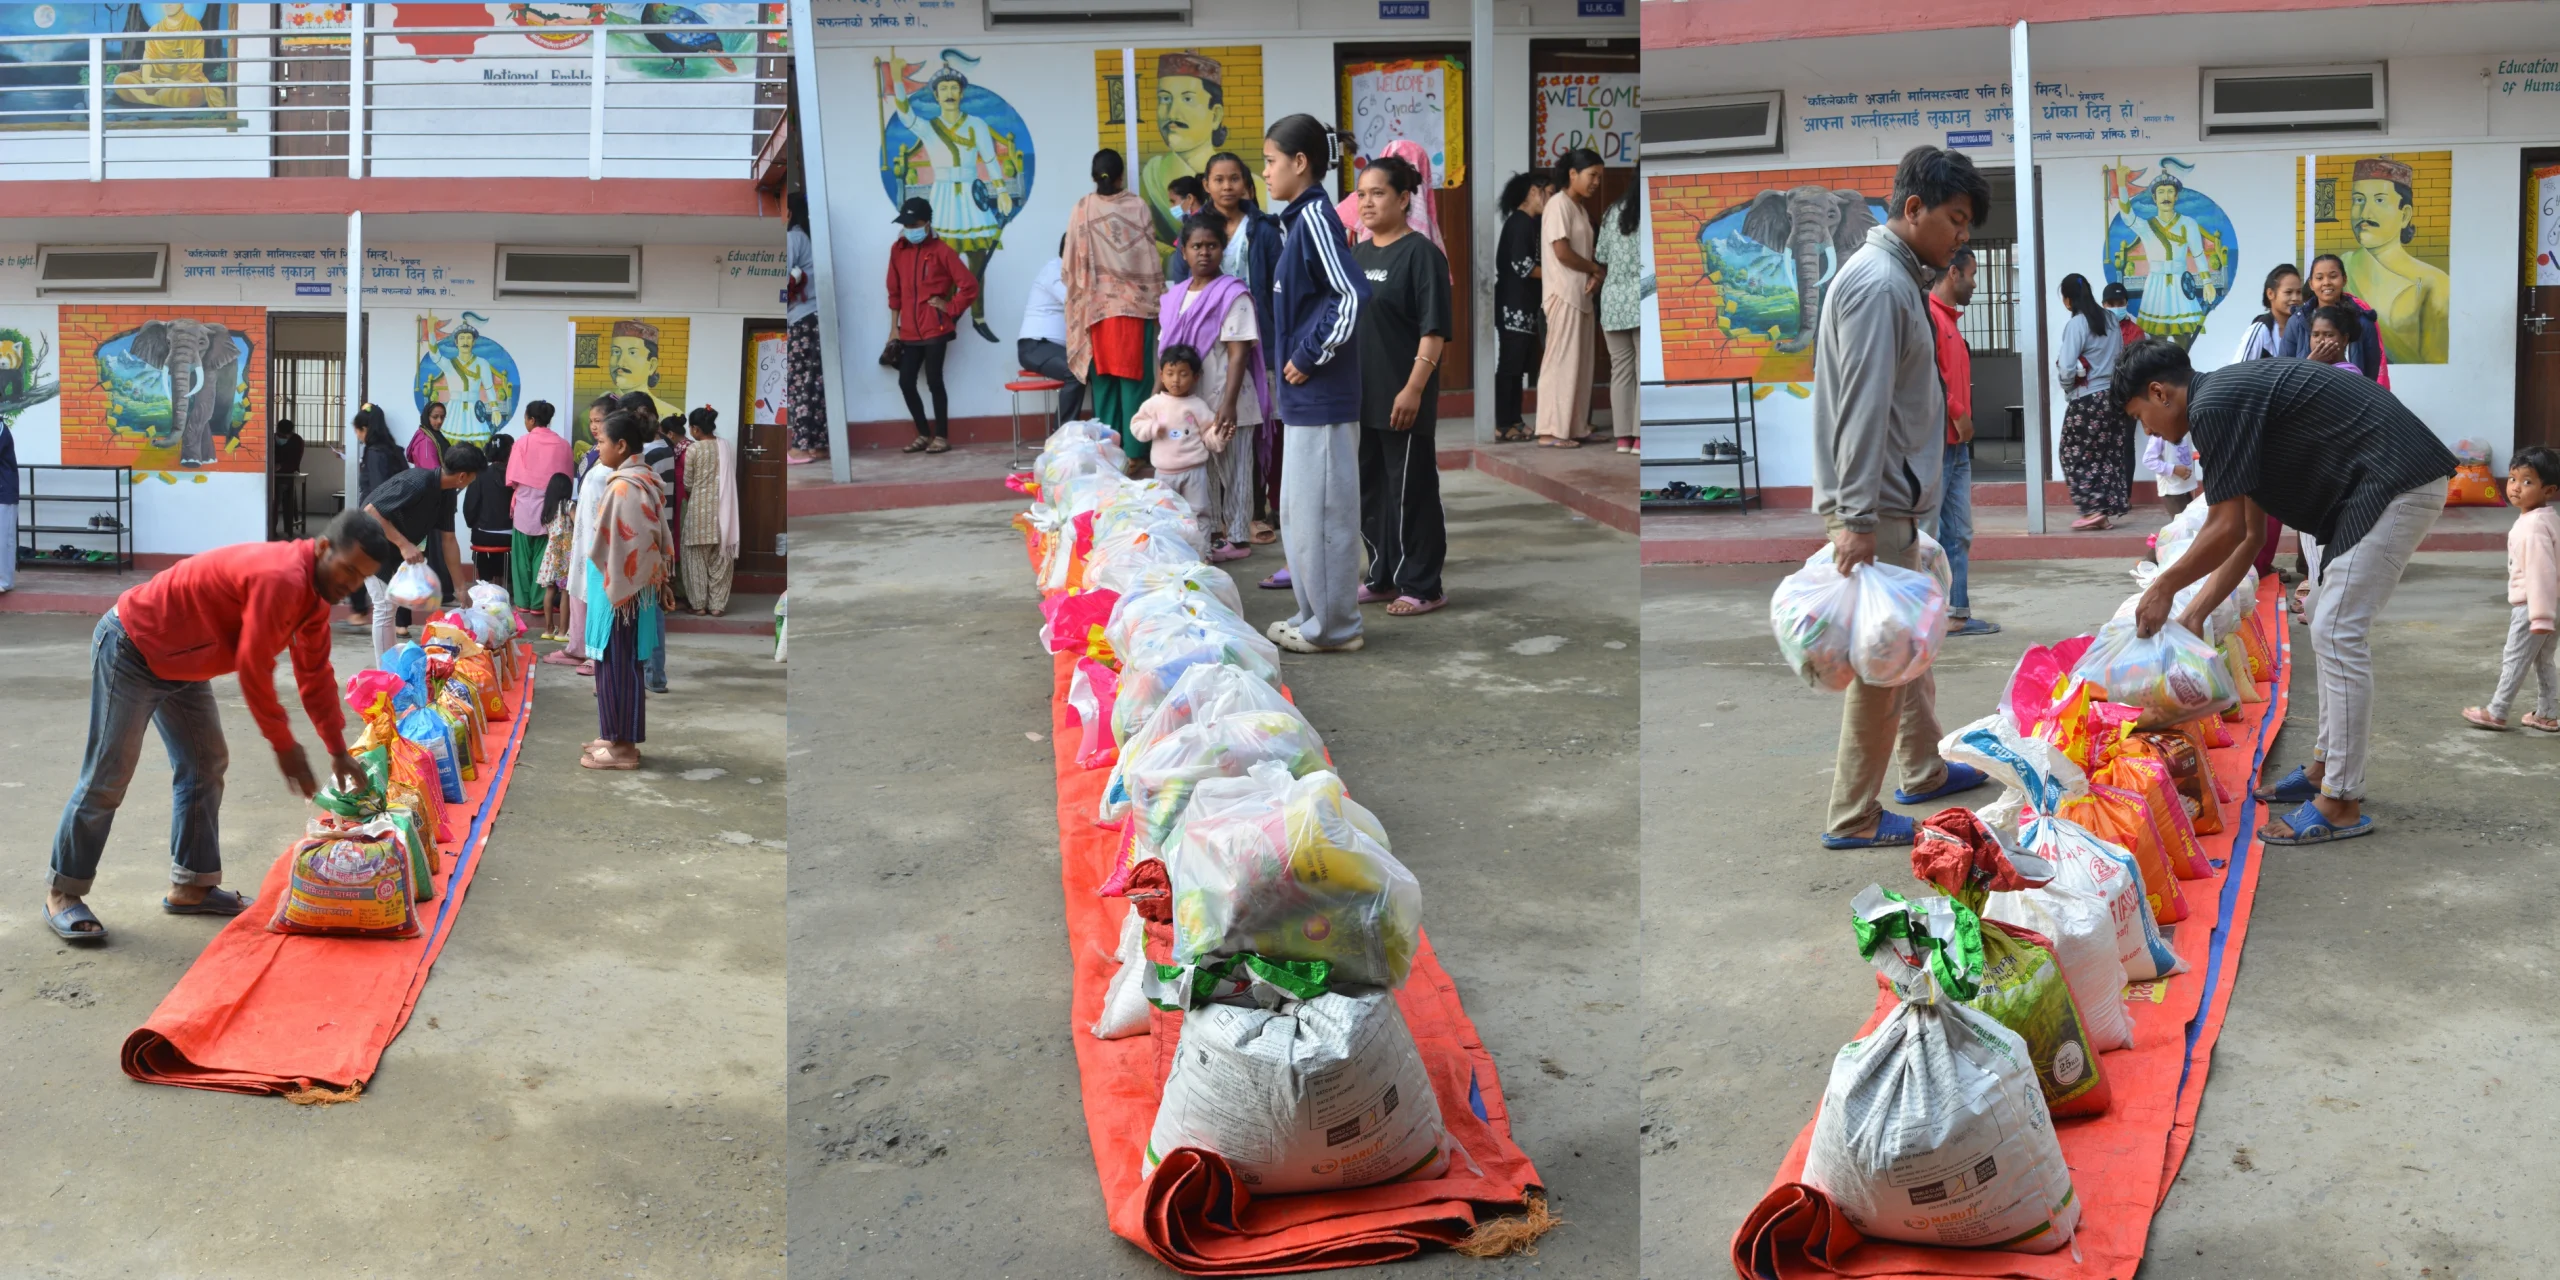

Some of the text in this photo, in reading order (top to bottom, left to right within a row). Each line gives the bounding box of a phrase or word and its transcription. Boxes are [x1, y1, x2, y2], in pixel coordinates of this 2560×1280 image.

[1382, 4, 1398, 15] PLAY
[1399, 4, 1420, 15] GROUP
[1585, 3, 1617, 13] U.K.G.
[2497, 58, 2559, 75] Education
[482, 68, 539, 87] National
[1545, 85, 1640, 108] WELCOME
[1975, 84, 1996, 99] पनि
[2502, 81, 2517, 97] of
[1383, 94, 1425, 118] Grade
[2042, 101, 2078, 120] धोका
[1582, 106, 1614, 130] TO
[8, 255, 16, 267] to
[727, 250, 775, 263] Education
[371, 262, 400, 279] धोका
[730, 266, 742, 280] of
[1971, 1022, 2013, 1054] PREMIUM
[1341, 1139, 1385, 1166] MARUTI
[1930, 1206, 1978, 1225] MARUTI
